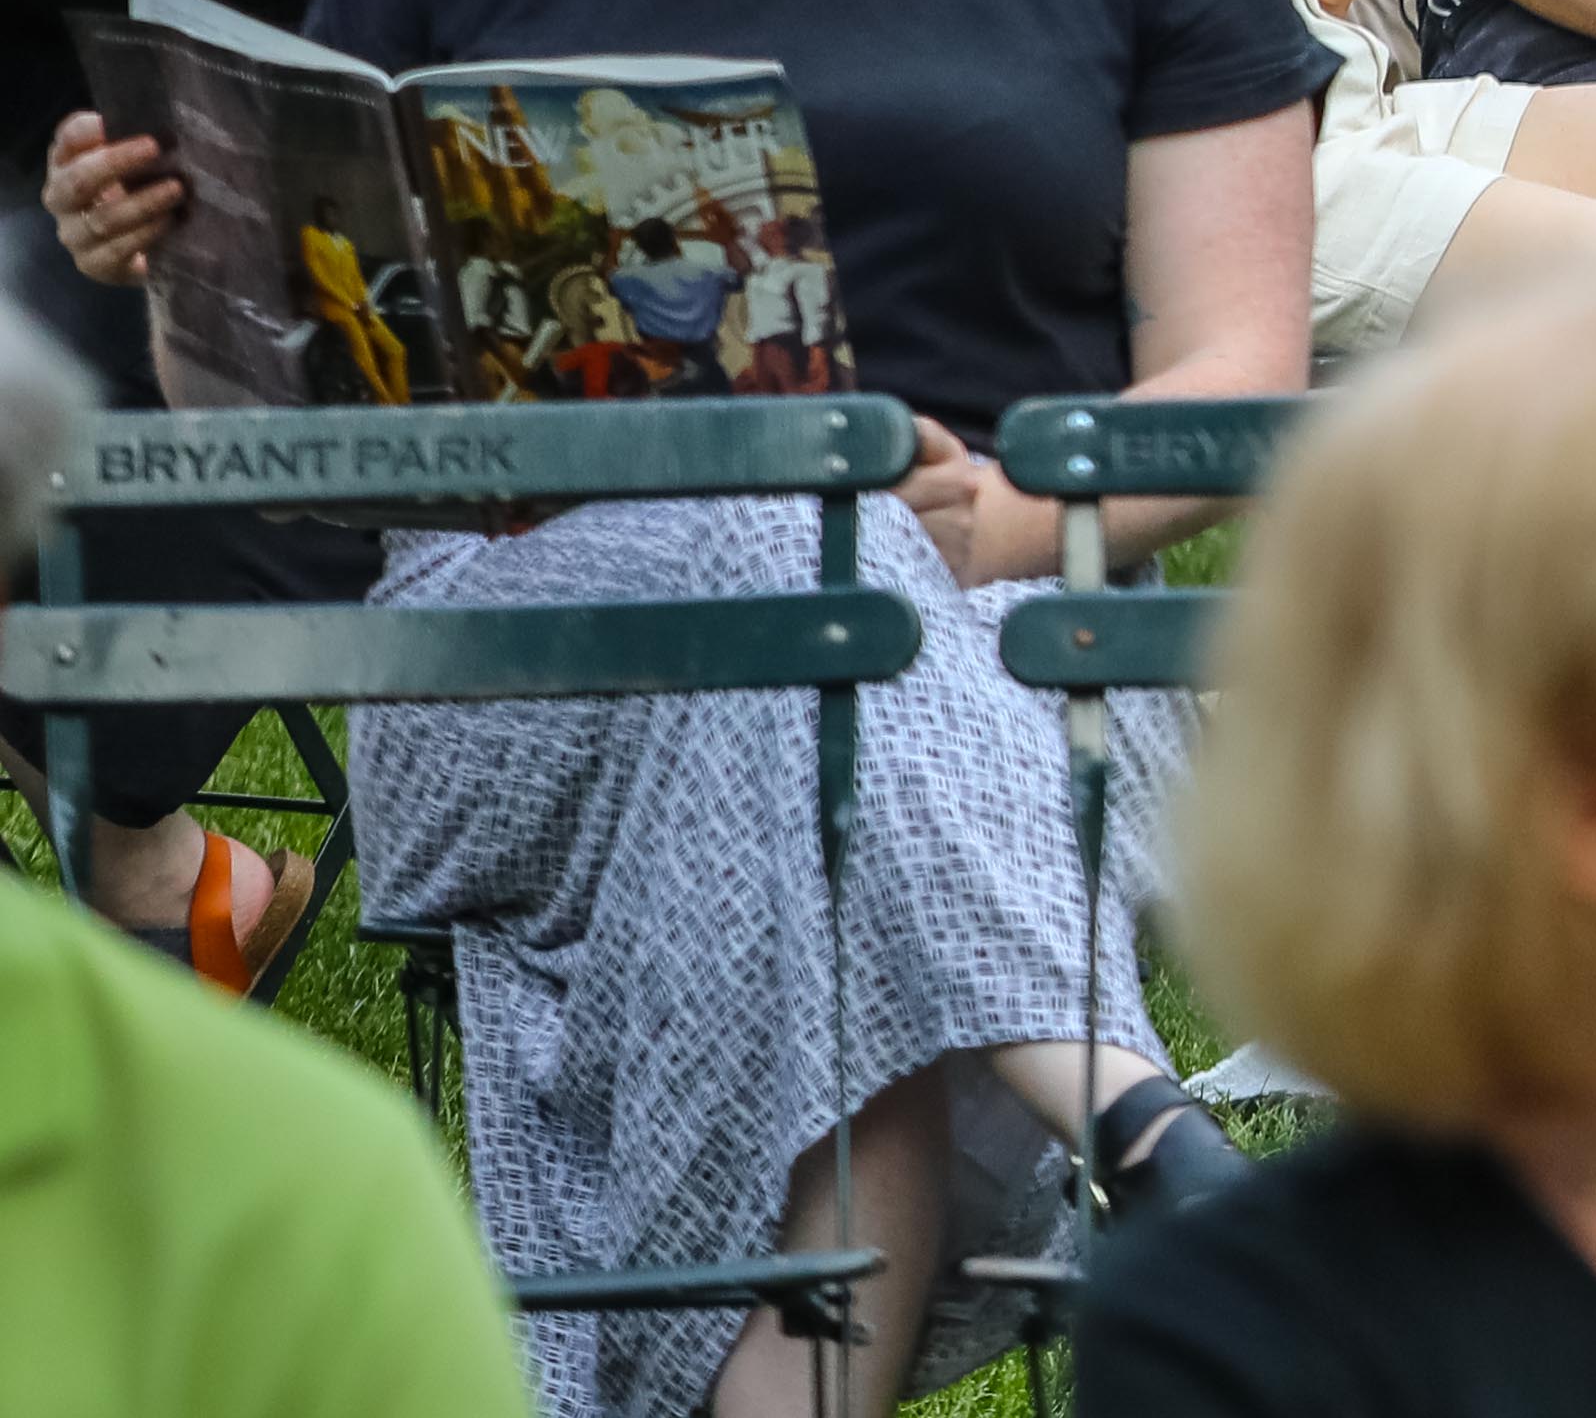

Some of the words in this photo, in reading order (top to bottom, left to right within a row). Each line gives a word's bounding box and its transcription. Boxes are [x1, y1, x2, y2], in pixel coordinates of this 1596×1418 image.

[455, 123, 574, 168] NEW
[99, 438, 340, 485] BRYANT
[352, 434, 517, 478] PARK
